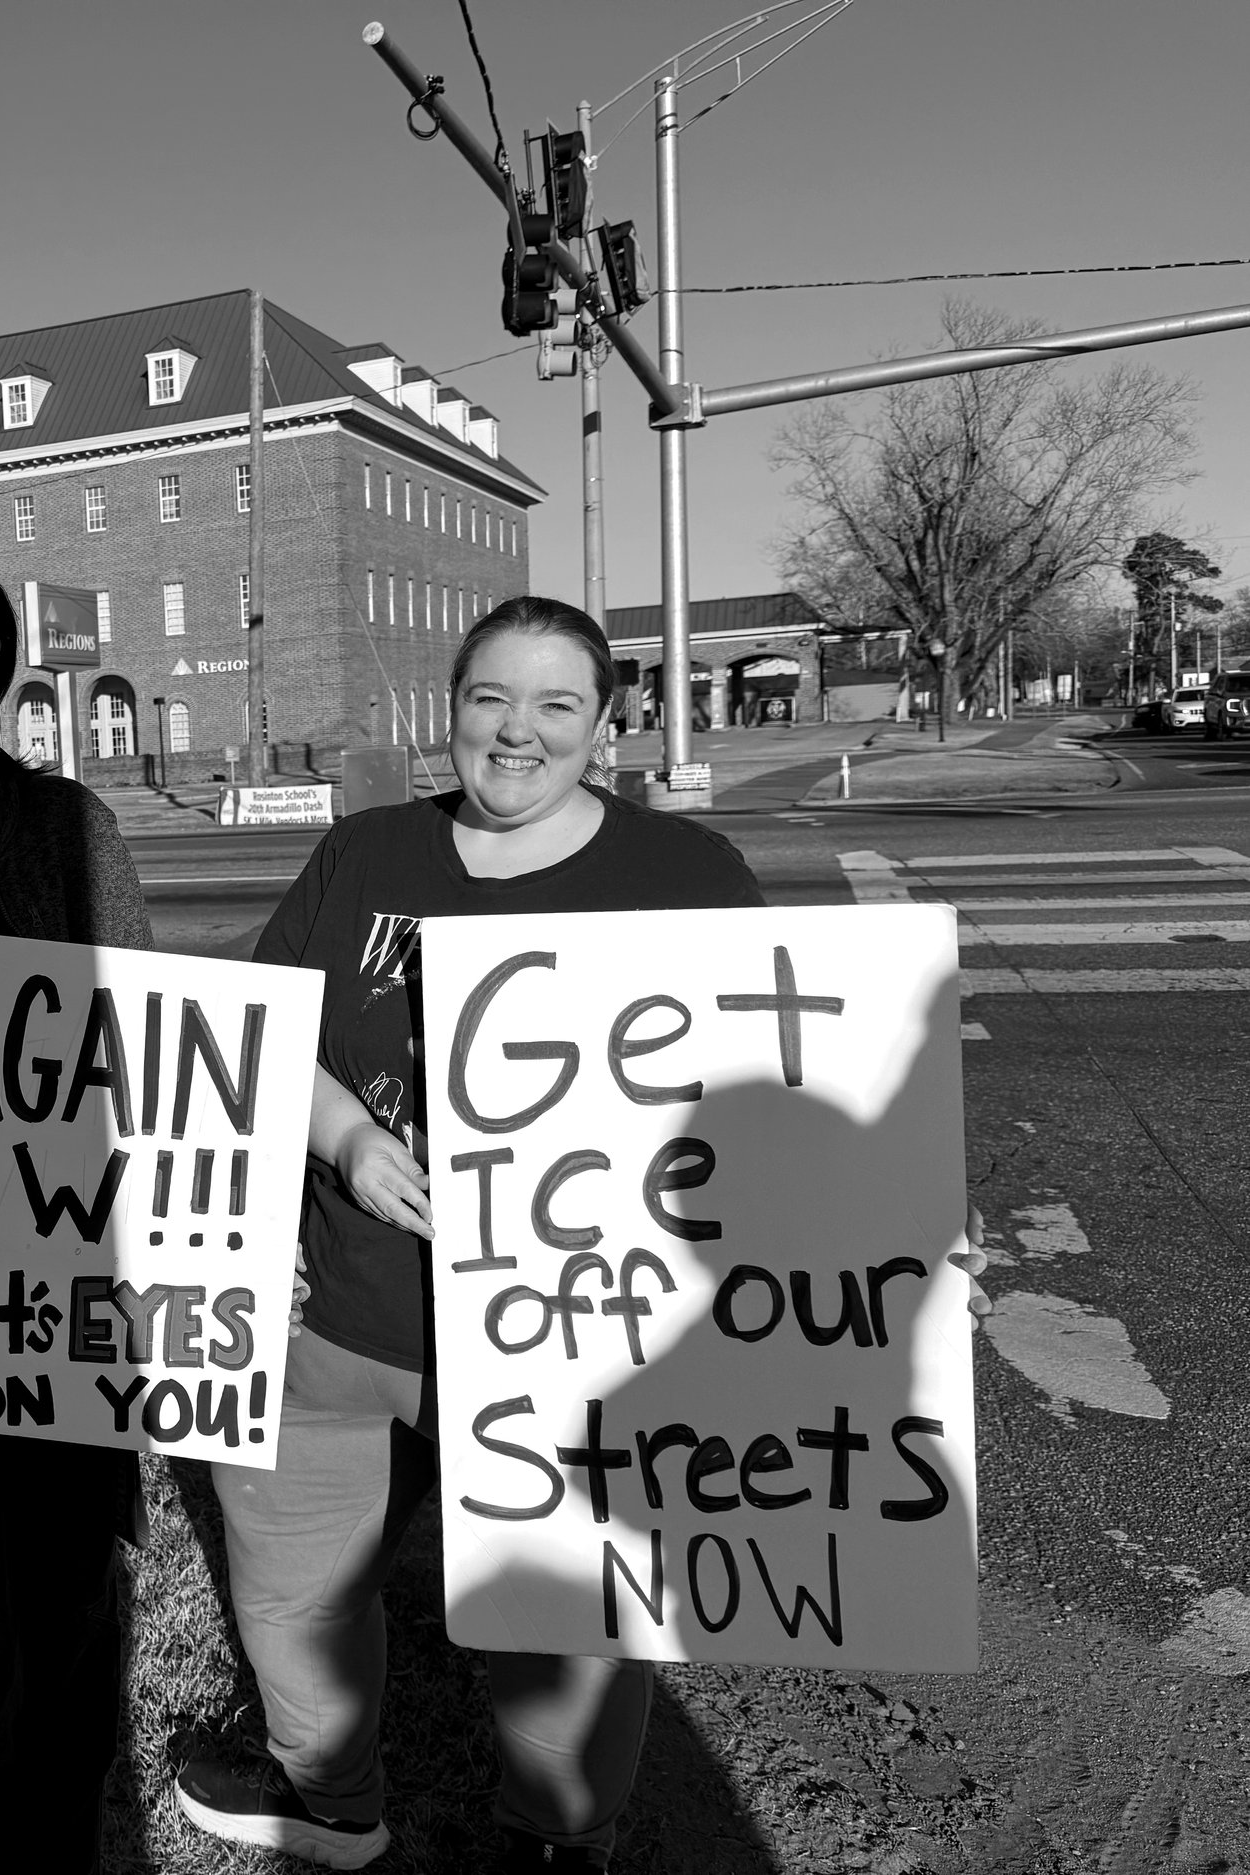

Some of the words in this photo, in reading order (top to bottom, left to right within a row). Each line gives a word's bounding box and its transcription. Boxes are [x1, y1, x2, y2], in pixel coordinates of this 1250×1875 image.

[48, 628, 96, 652] REGIONS
[265, 802, 302, 813] Armadillo
[303, 801, 323, 812] Dash
[284, 789, 317, 800] School's
[447, 945, 844, 1133] Get
[451, 1137, 722, 1272] Ice
[68, 1276, 255, 1370] EYES
[485, 1248, 678, 1365] off
[712, 1257, 928, 1348] our
[460, 1395, 950, 1522] Streets
[603, 1529, 844, 1647] NOW
